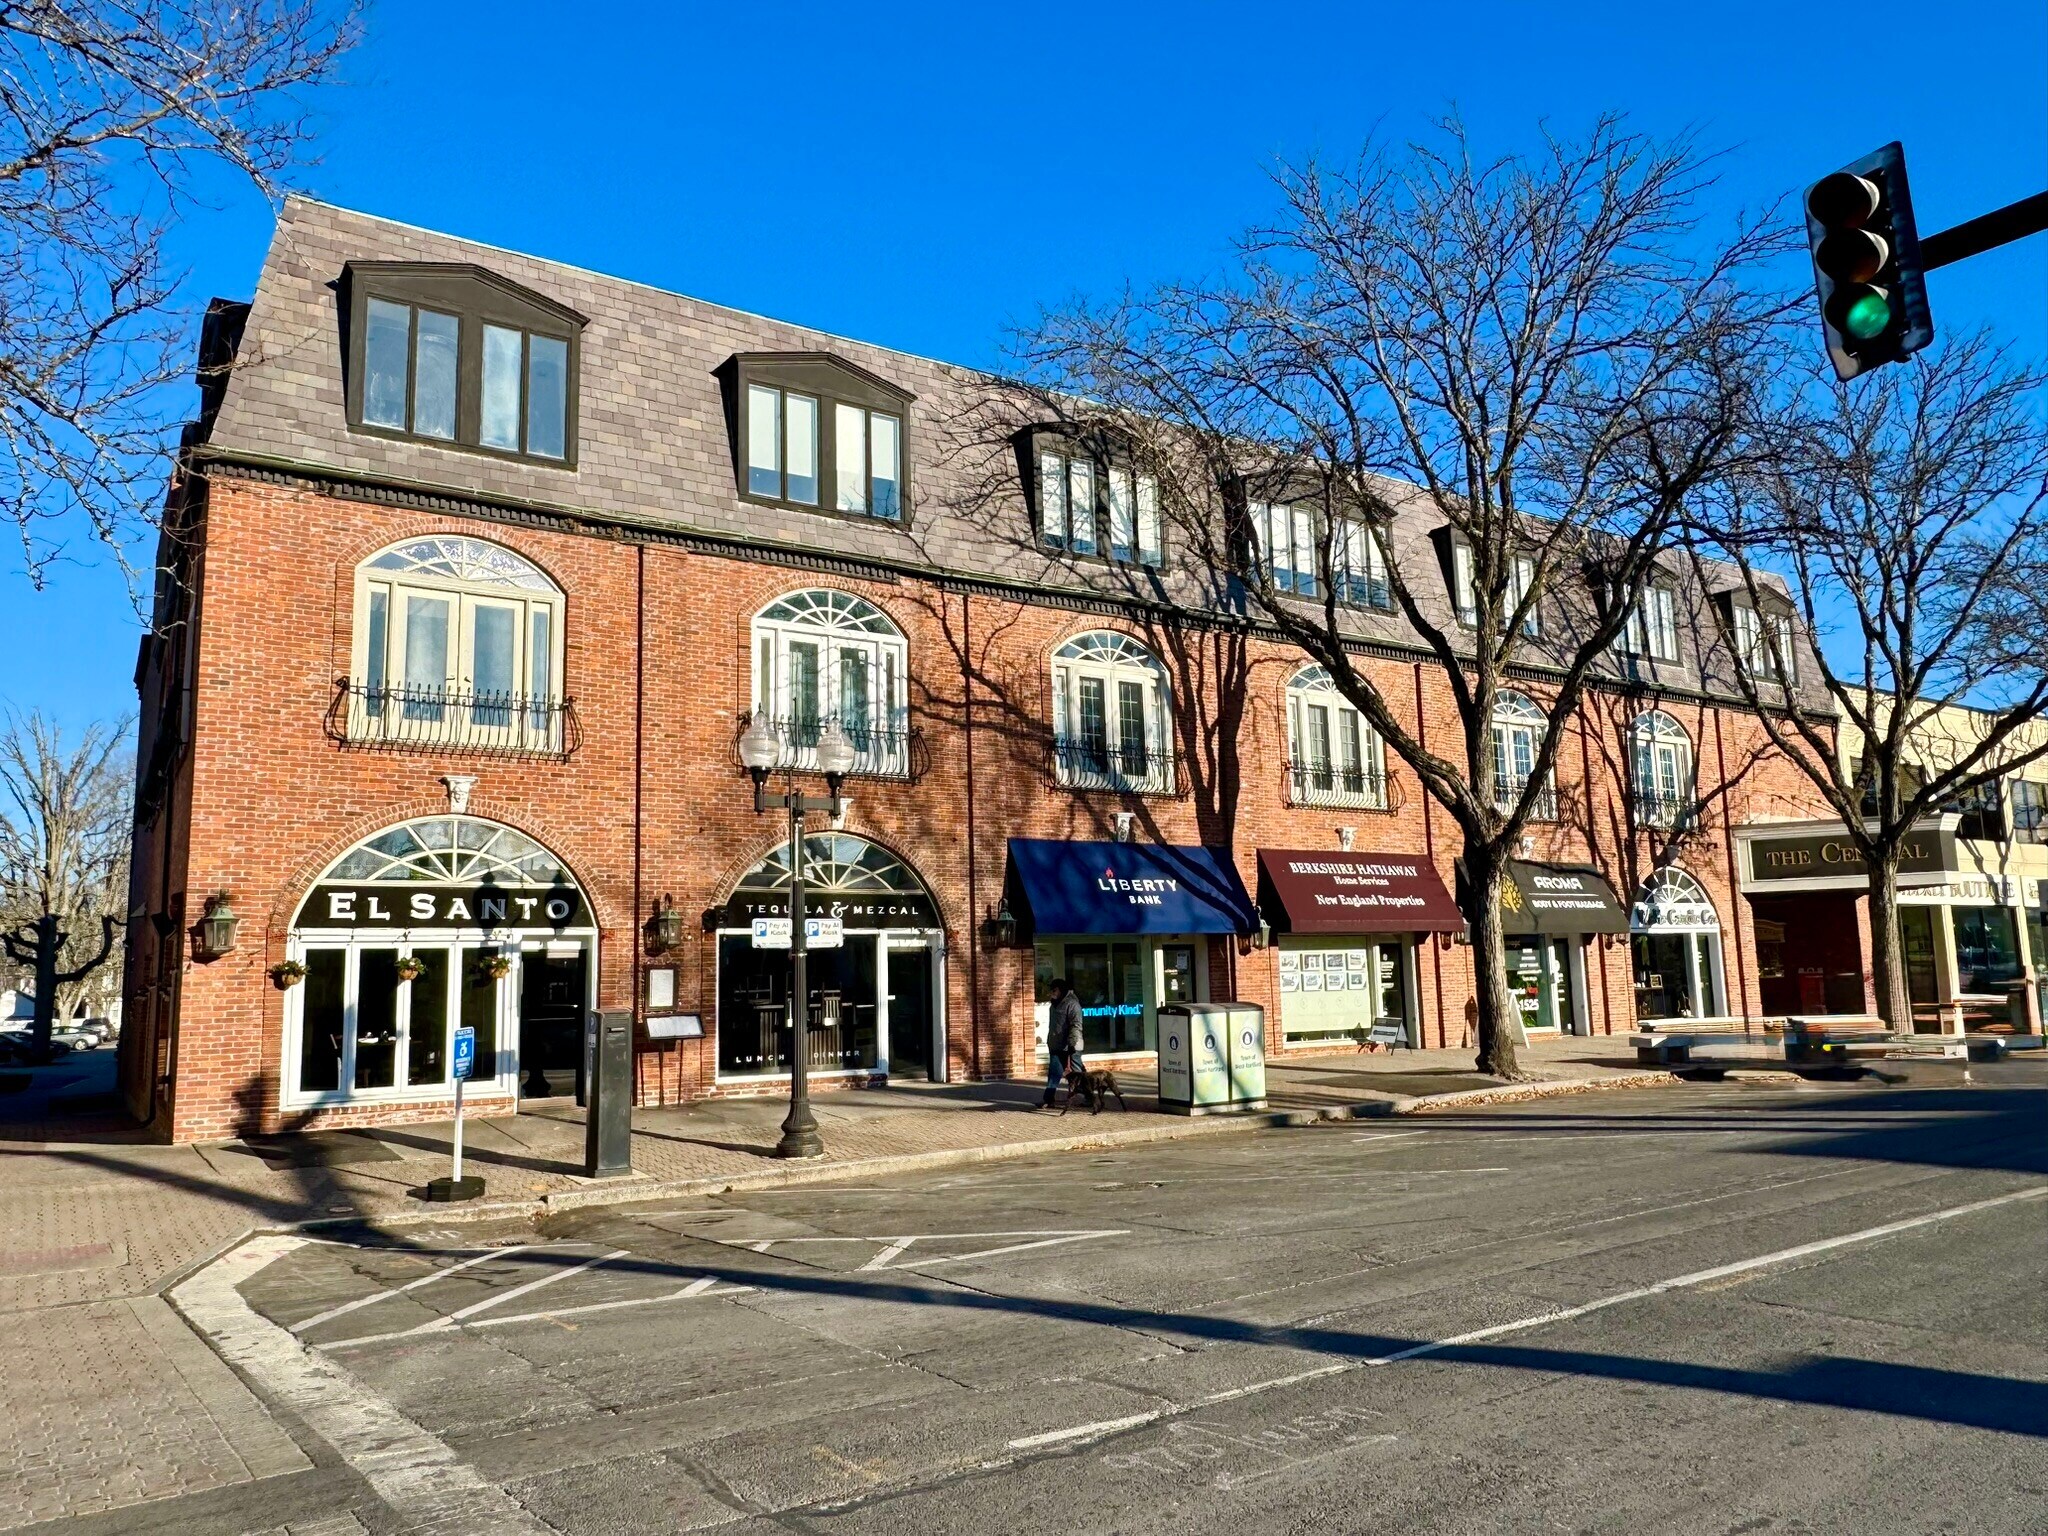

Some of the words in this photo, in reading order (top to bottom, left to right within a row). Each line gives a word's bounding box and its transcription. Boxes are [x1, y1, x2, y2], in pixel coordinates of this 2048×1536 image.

[1766, 850, 1811, 866] THE
[1821, 842, 1929, 864] CENAL
[1288, 862, 1357, 874] BERKSHIRE
[1355, 864, 1418, 876] HATHAWAY
[1098, 878, 1177, 892] LIBERTY
[1333, 876, 1358, 885] Home
[1358, 877, 1390, 886] Services
[1533, 876, 1584, 890] AROMA
[328, 892, 391, 921] EL
[410, 893, 570, 920] SANTO
[1128, 895, 1162, 905] BANK
[1314, 894, 1339, 905] New
[1338, 895, 1379, 907] England
[1377, 895, 1426, 908] Properties
[746, 904, 824, 914] TEQULA
[830, 901, 849, 919] &
[853, 905, 919, 915] MEZCAL
[1082, 1004, 1118, 1018] mmunity
[735, 1054, 785, 1063] LUNCH
[813, 1050, 860, 1059] DINNER
